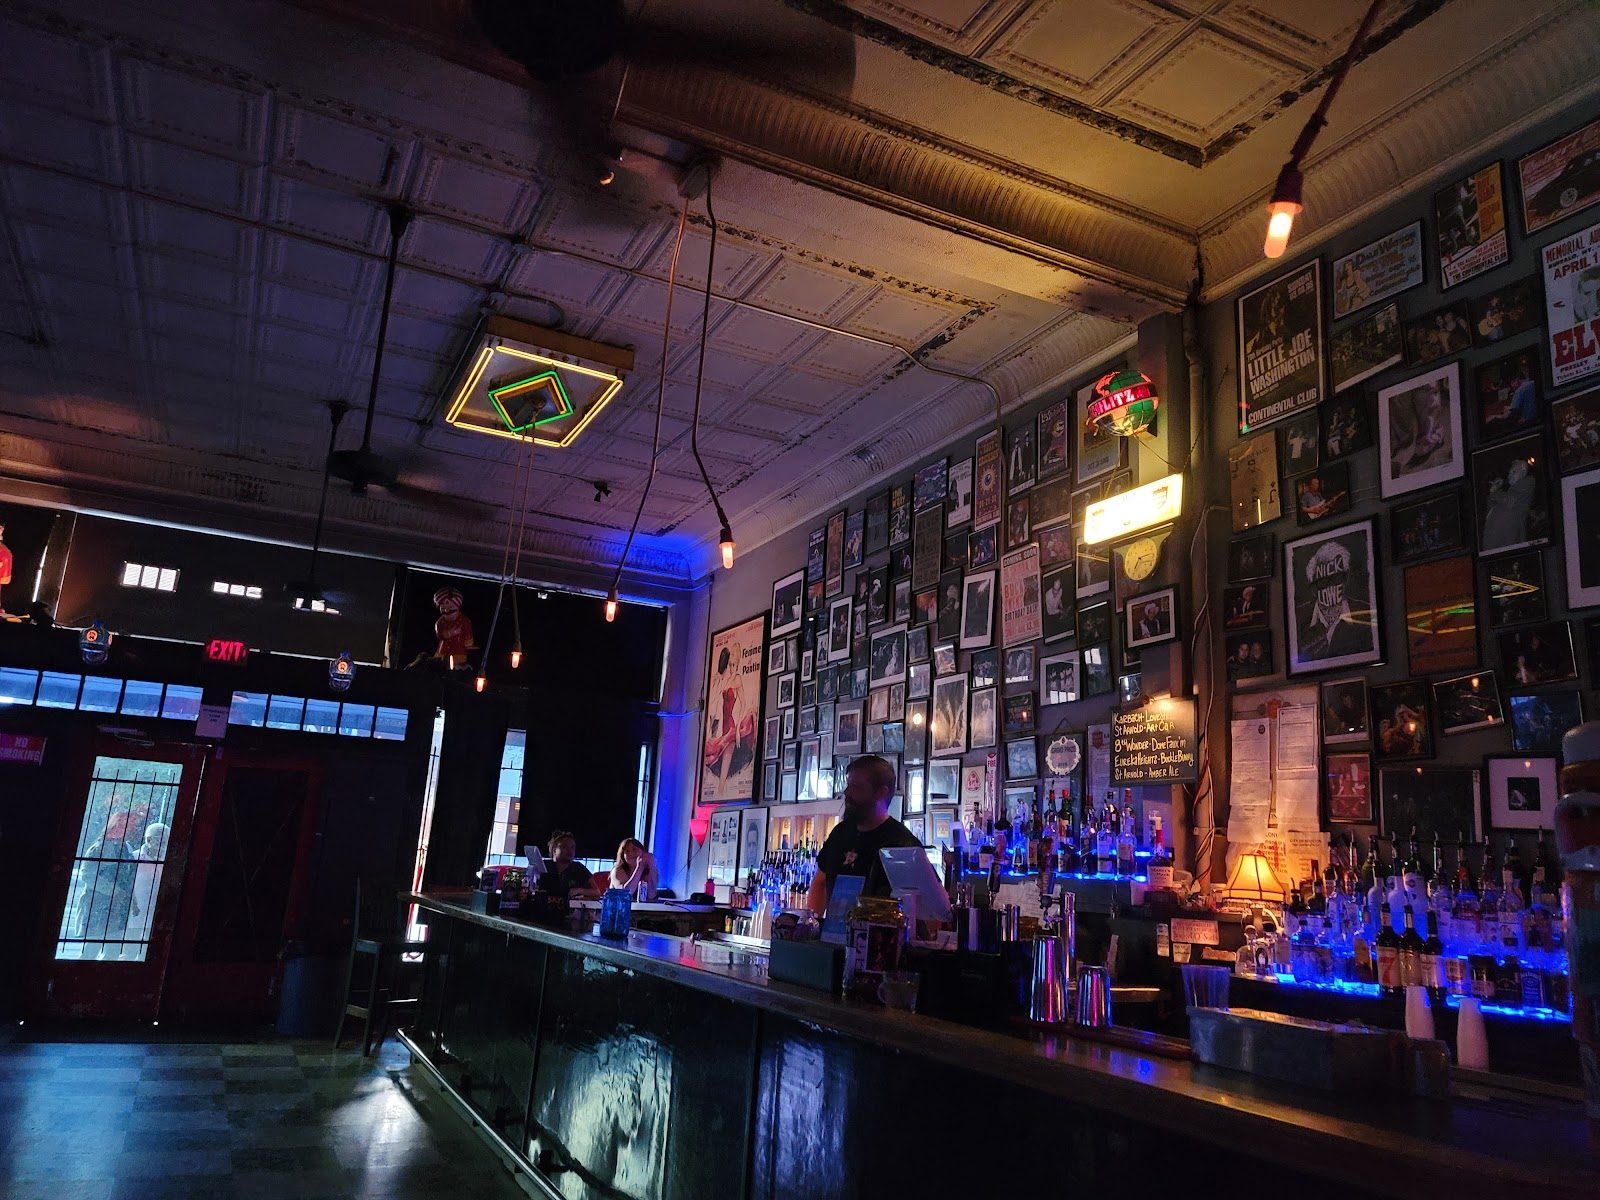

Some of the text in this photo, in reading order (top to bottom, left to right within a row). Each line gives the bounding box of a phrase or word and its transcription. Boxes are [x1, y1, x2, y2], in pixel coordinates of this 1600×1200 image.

[1545, 236, 1585, 264] MEMORIAL
[1553, 257, 1591, 280] APRIL
[1247, 343, 1286, 381] LITTLE
[1289, 328, 1313, 357] JOE
[1249, 347, 1316, 395] WASHINGTON
[1248, 396, 1296, 425] CONTINENTAL
[1297, 387, 1317, 405] CLUB
[1315, 555, 1344, 579] NICK
[1317, 584, 1343, 607] LOWE
[208, 638, 244, 664] EXIT
[14, 736, 28, 748] NO
